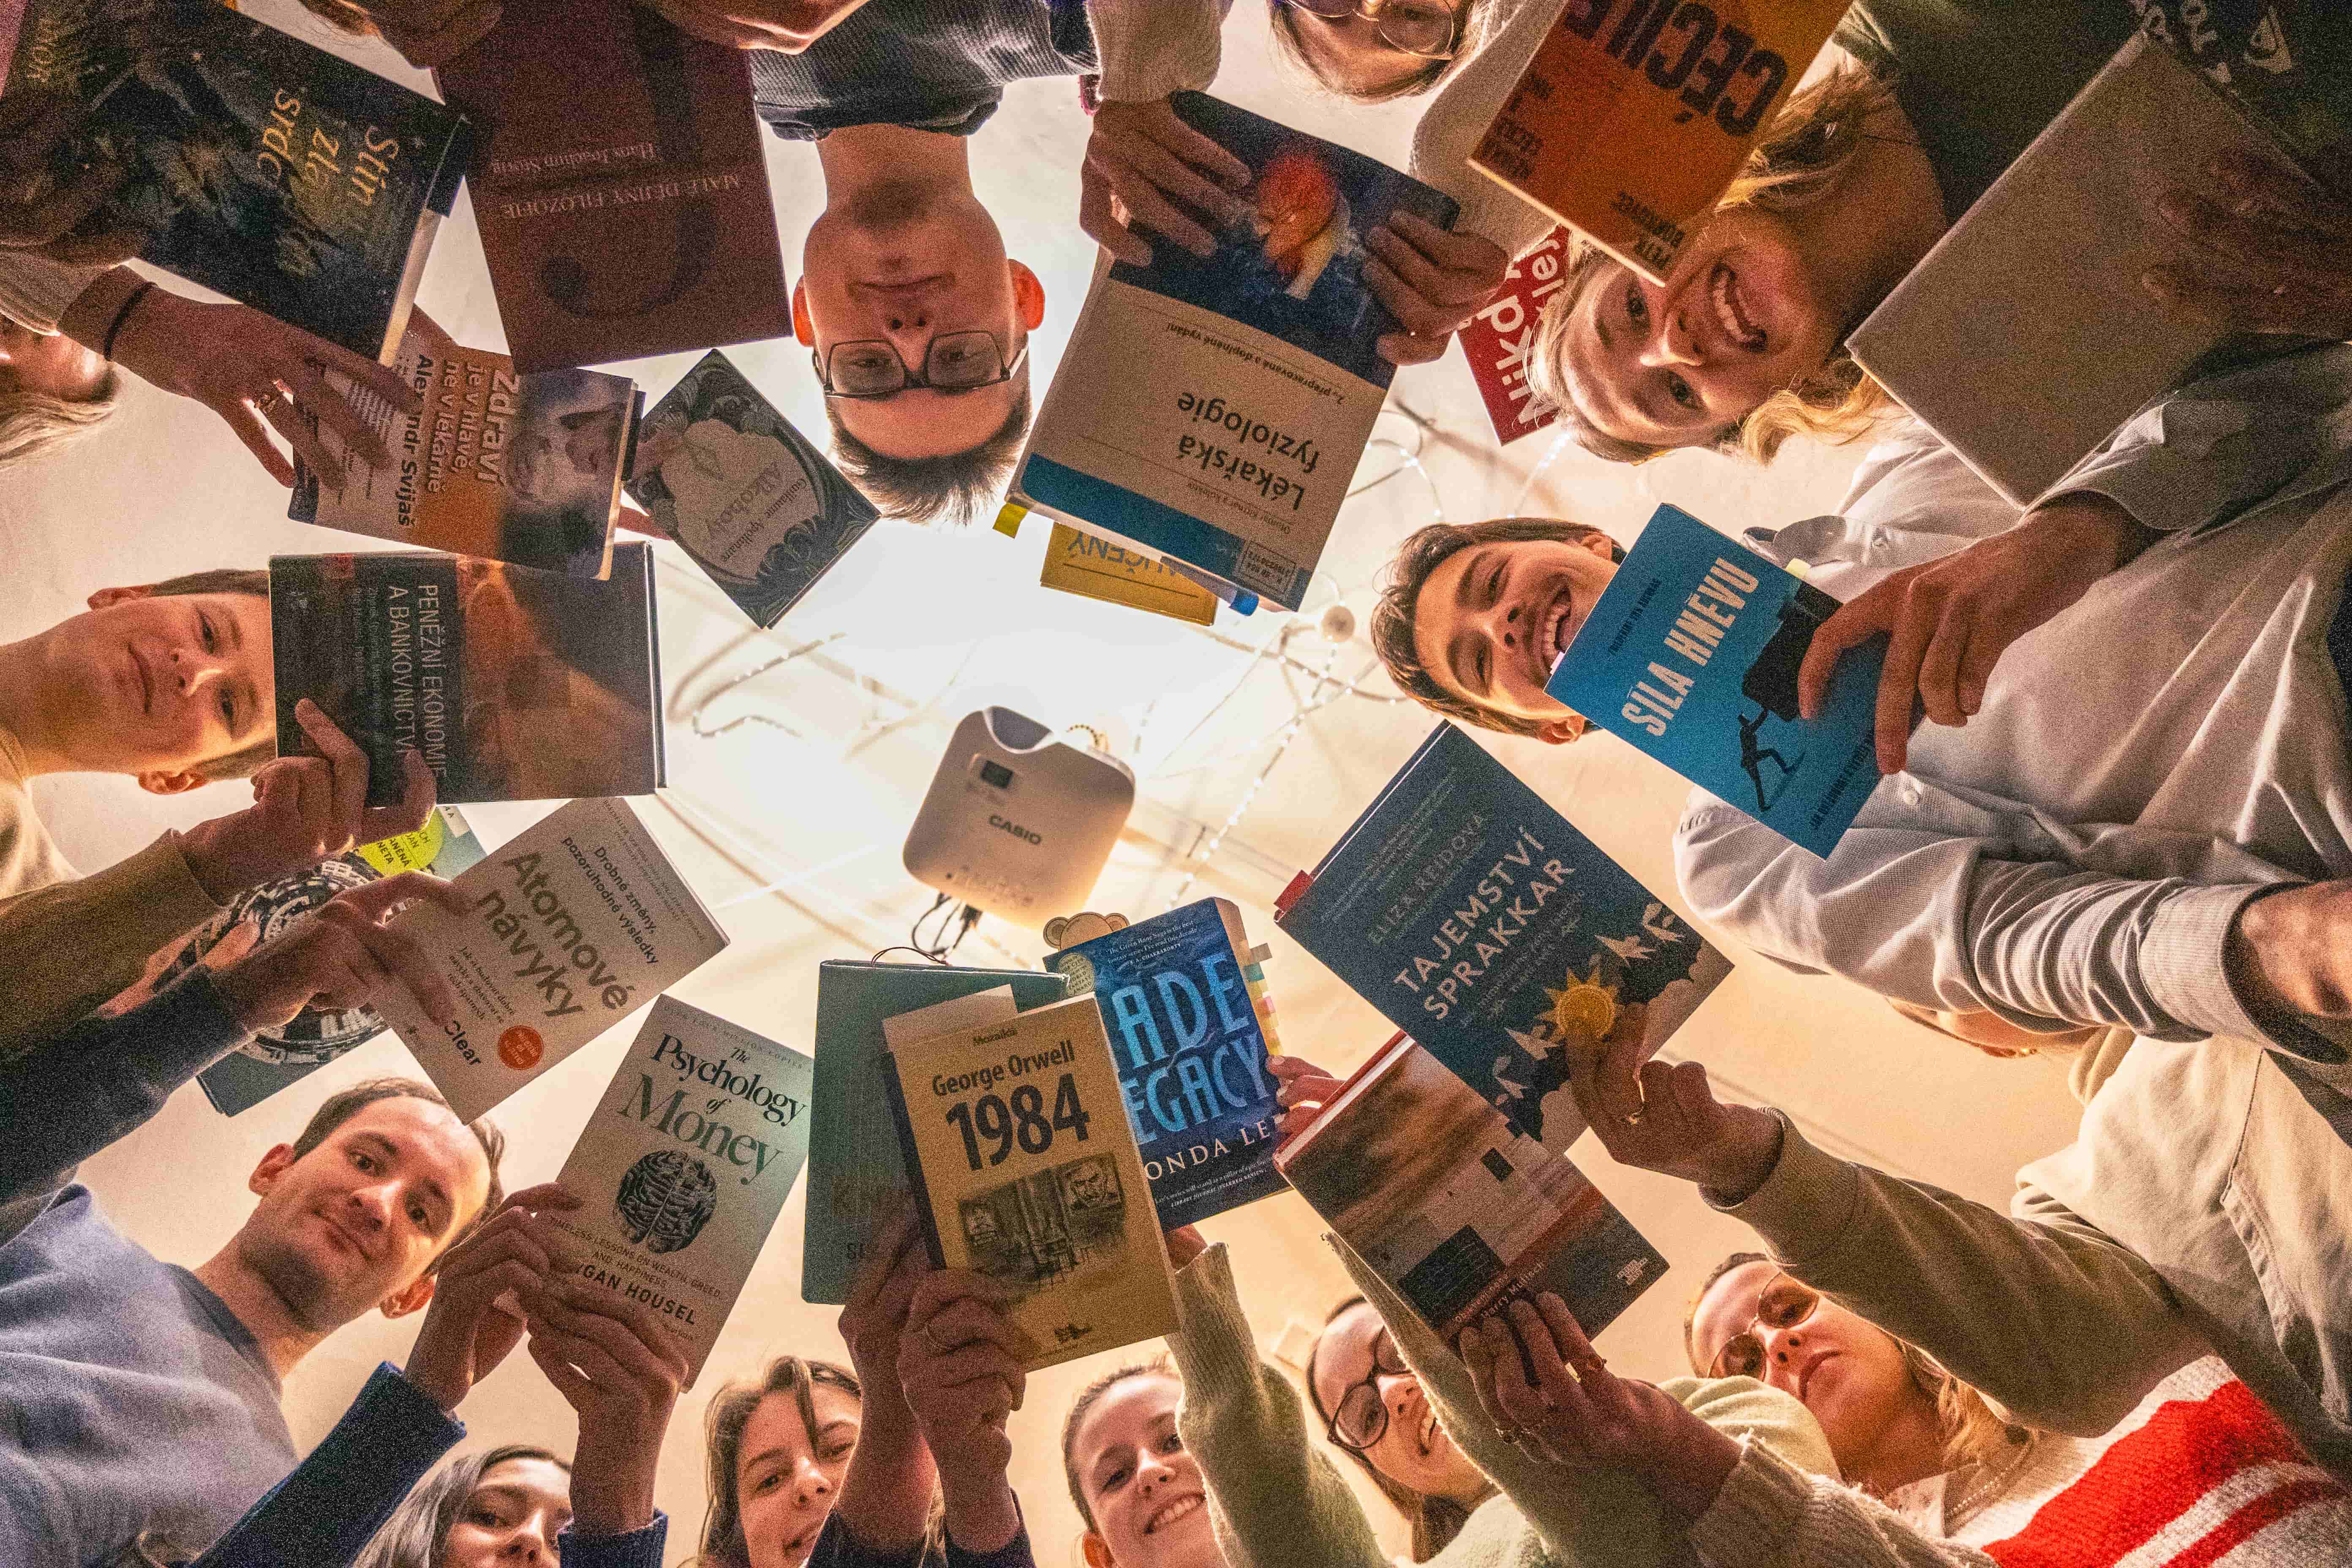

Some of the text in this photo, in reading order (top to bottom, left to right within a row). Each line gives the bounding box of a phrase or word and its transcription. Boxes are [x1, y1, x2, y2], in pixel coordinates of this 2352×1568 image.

[343, 124, 404, 210] Stín
[499, 173, 742, 220] MALÉ DĚJINY FILOZOFIE
[1165, 319, 1203, 344] vydání
[1473, 294, 1562, 425] Nikd
[402, 354, 434, 456] Alexndr
[448, 362, 486, 476] je v hlavě,
[1260, 359, 1333, 399] přepracované
[427, 360, 460, 493] ne v lékárně
[476, 368, 521, 486] Zdraví
[1171, 383, 1326, 476] fyziologie
[395, 459, 418, 527] Svijaš
[1172, 432, 1309, 512] Lékařská
[716, 476, 810, 566] Guillaume Apollinaire
[387, 585, 408, 599] A
[416, 584, 446, 670] PENĚŽNÍ
[1615, 653, 1696, 740] SÍLA
[1659, 551, 1761, 669] HNĚVU
[988, 814, 1042, 846] CASIO
[500, 840, 639, 1015] Atomové
[561, 835, 664, 968] pozoruhodné výsledky
[593, 845, 661, 936] Drobné změny,
[1367, 890, 1418, 947] ELIZA
[1393, 823, 1546, 999] TAJEMSTVÍ
[473, 883, 590, 1031] návyky
[1119, 940, 1138, 951] Green
[1421, 852, 1576, 1023] SPRAKKAR
[457, 987, 487, 1022] špatných
[458, 945, 474, 961] Jak
[474, 965, 501, 996] budovat
[496, 992, 517, 1017] dobré
[472, 983, 500, 1015] zbavovat
[1108, 950, 1250, 1070] ADE
[442, 1018, 486, 1068] Clear
[646, 1028, 811, 1135] Psychology
[729, 1045, 752, 1065] The
[930, 1039, 1076, 1102] George Orwell
[703, 1091, 732, 1120] of
[943, 1070, 1095, 1176] 1984
[1119, 1032, 1271, 1145] EGACY
[610, 1067, 790, 1195] Money
[1143, 1119, 1271, 1182] ONDA LE
[548, 1214, 594, 1242] TIMELESS
[593, 1234, 637, 1261] LESSONS
[636, 1253, 651, 1266] ON
[591, 1248, 668, 1290] AND HAPPINESS
[575, 1259, 700, 1326] GAN HOUSEL
[1480, 1292, 1511, 1323] Harry
